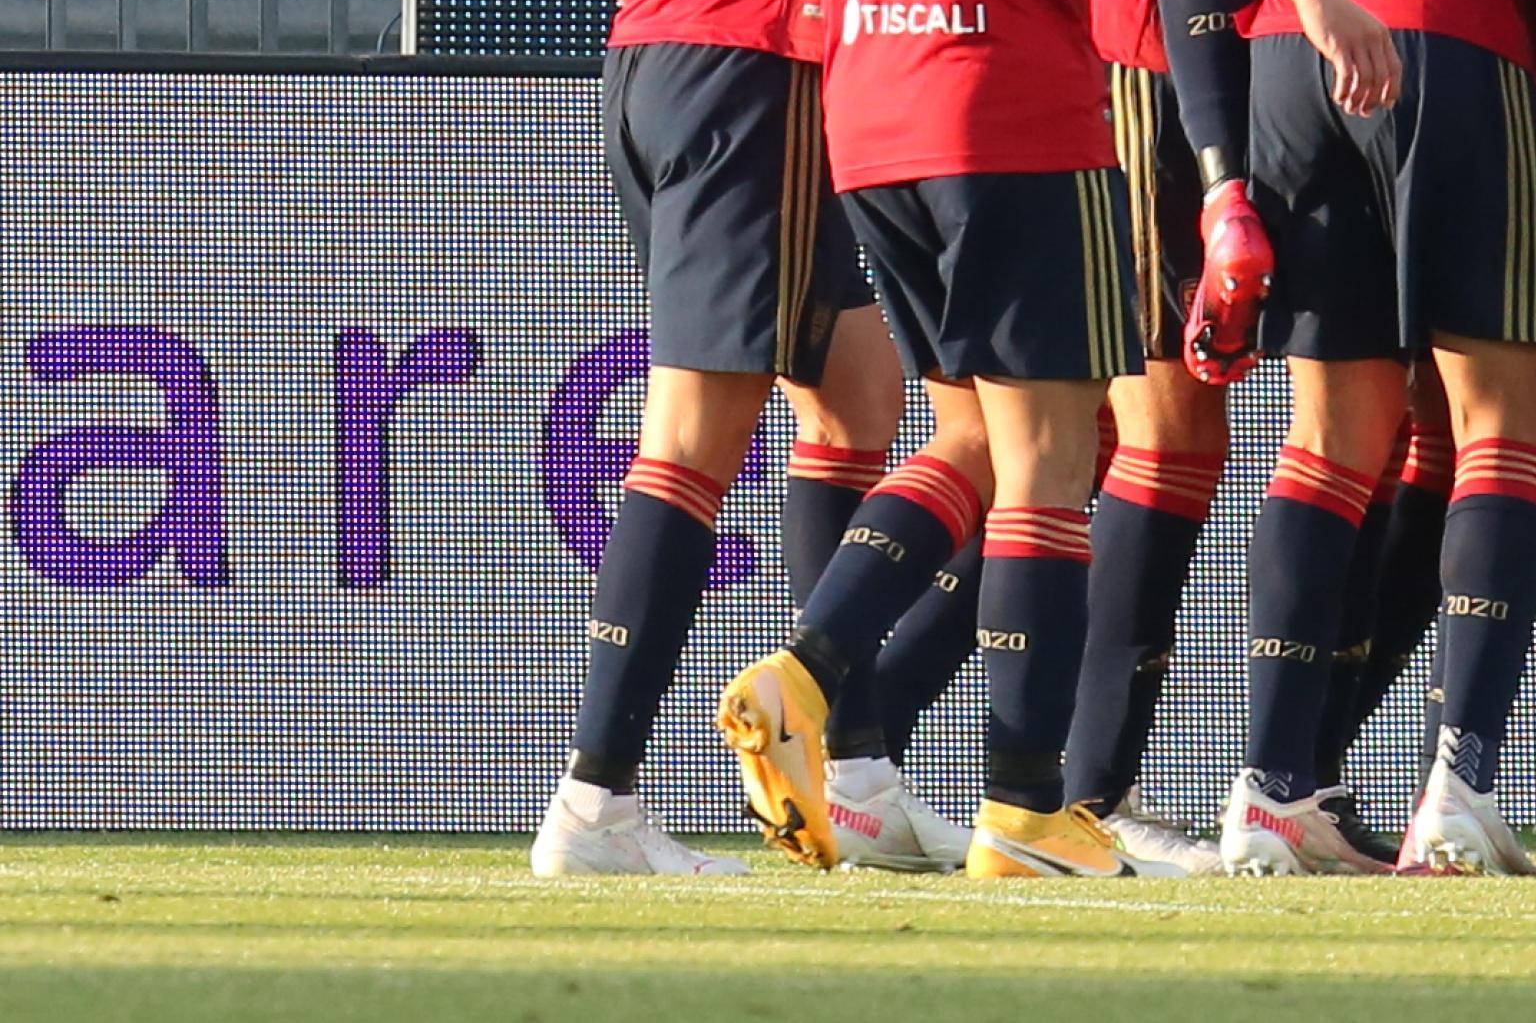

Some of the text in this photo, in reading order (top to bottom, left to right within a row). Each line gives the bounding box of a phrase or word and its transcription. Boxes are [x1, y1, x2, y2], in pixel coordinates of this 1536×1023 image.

[860, 2, 987, 35] TISCALI
[1186, 11, 1235, 36] 20
[1447, 594, 1510, 620] 2020
[1250, 637, 1317, 663] 2020
